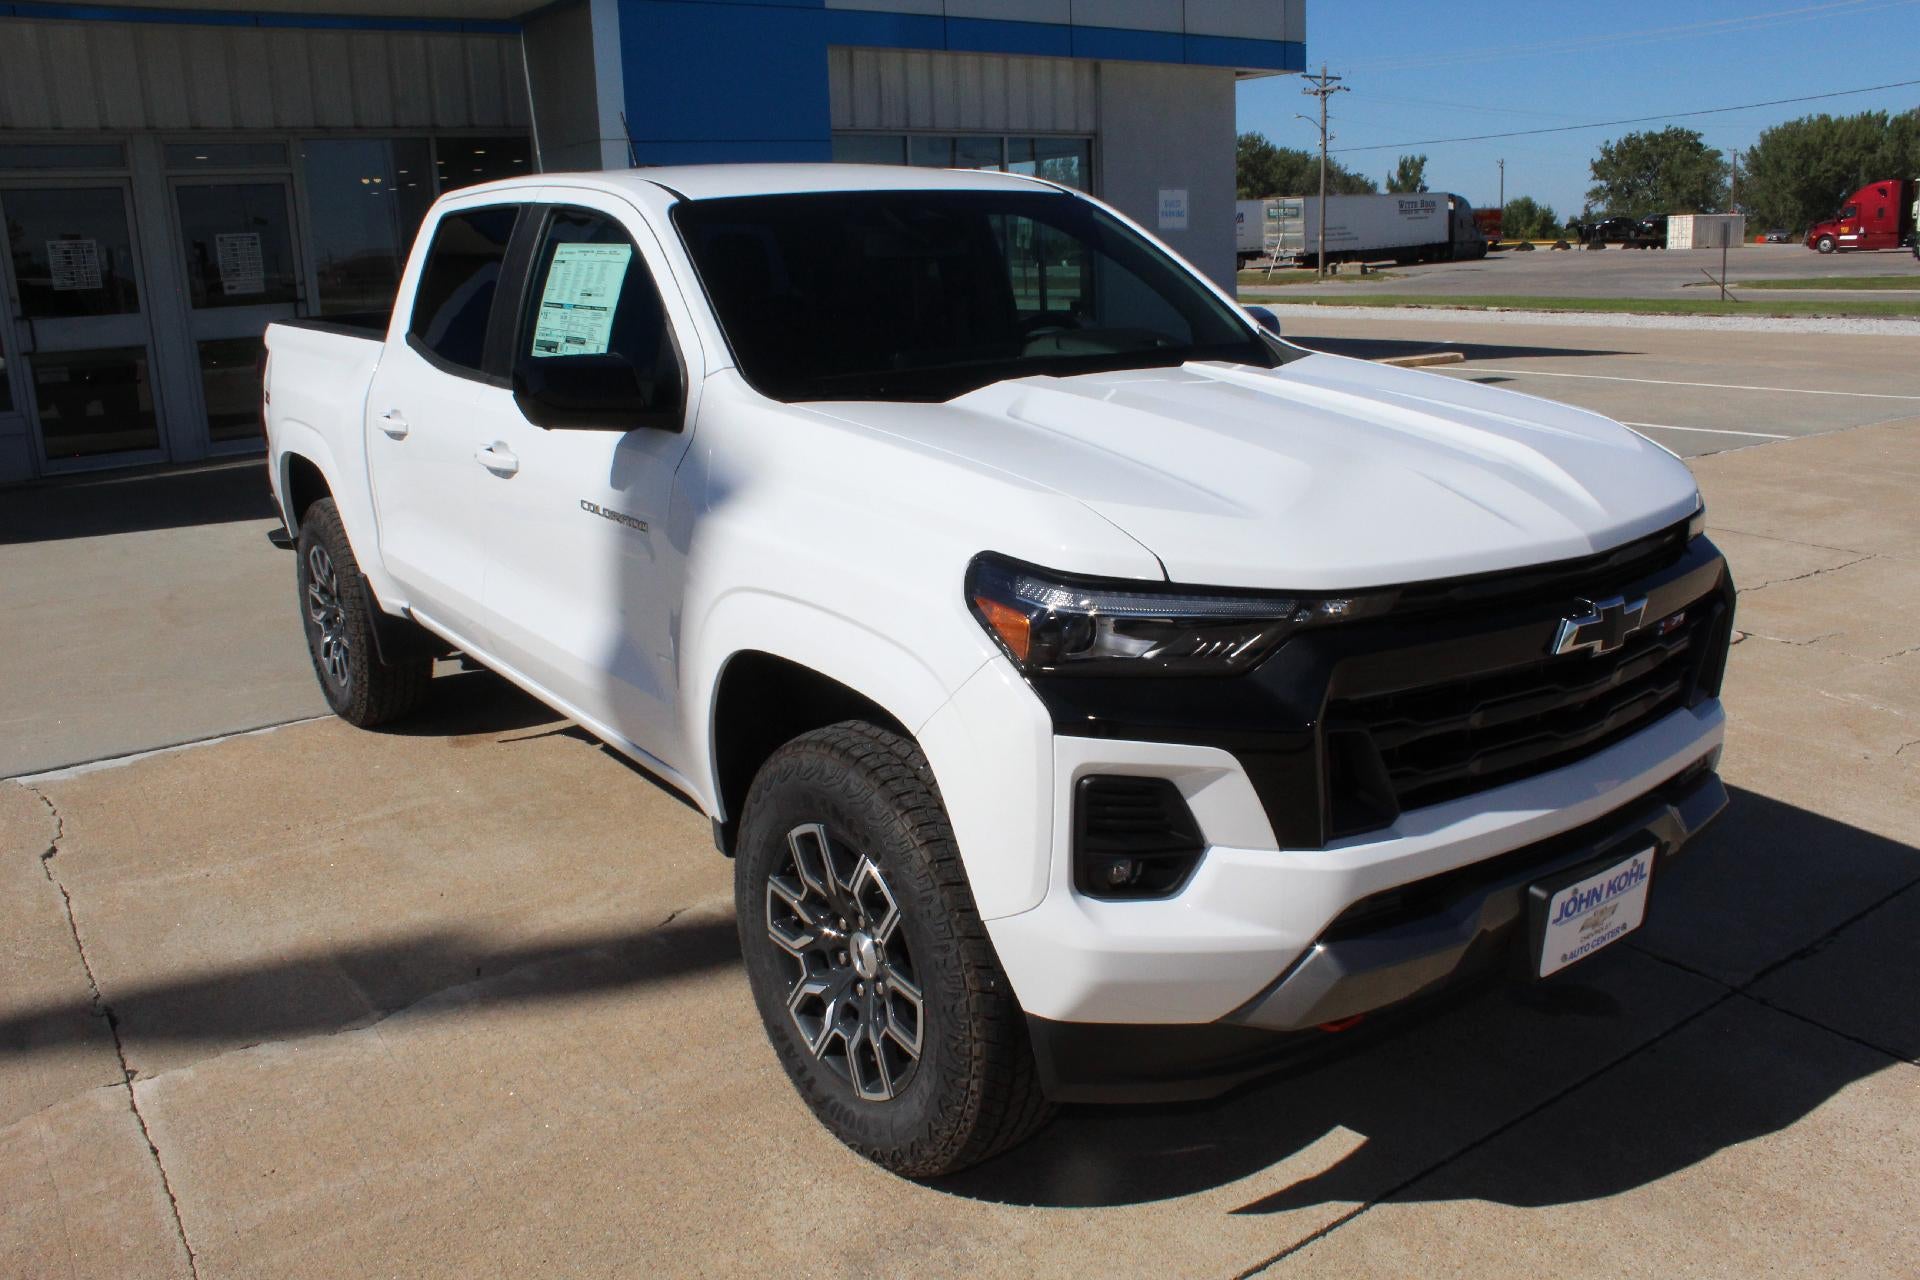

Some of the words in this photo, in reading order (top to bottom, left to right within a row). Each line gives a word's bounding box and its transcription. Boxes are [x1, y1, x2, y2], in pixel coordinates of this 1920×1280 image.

[581, 499, 649, 533] COLORADO
[1552, 883, 1604, 925] JOHN
[1606, 861, 1647, 898] KOHL
[1568, 943, 1590, 961] AUTO
[1591, 926, 1622, 949] CENTER
